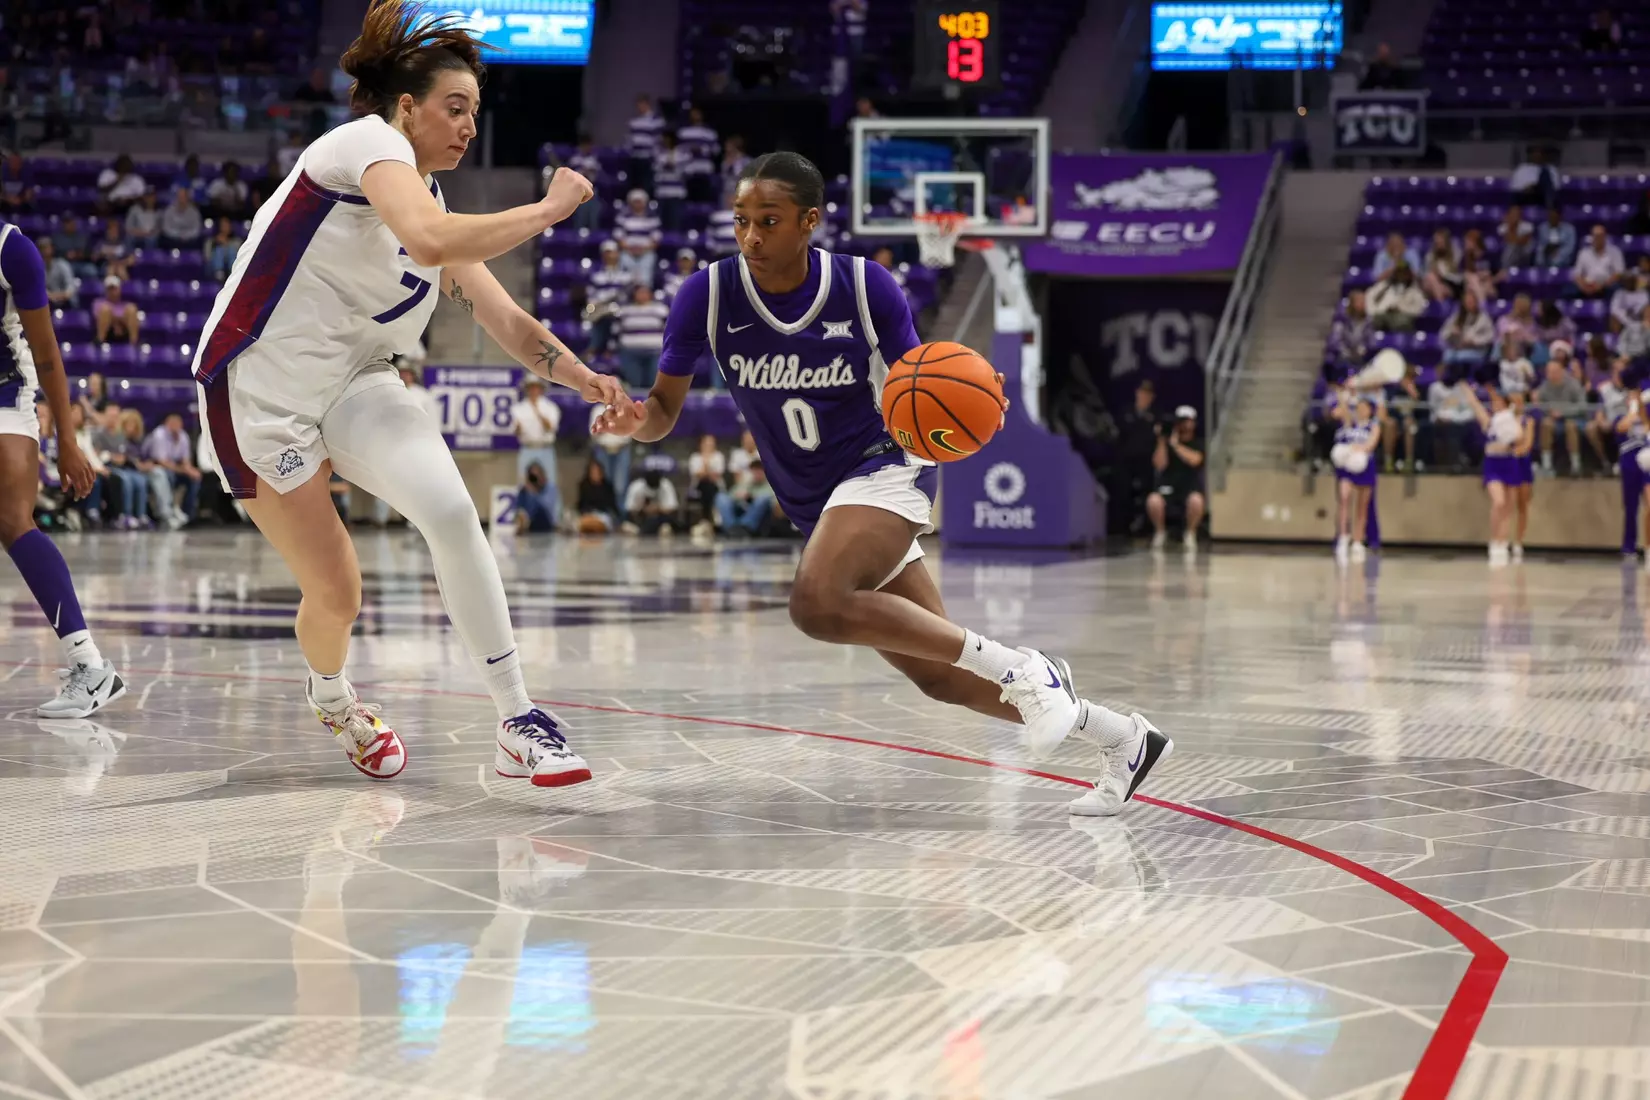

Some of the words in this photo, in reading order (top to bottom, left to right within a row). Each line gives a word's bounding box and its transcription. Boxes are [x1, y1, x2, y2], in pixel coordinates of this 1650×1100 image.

[947, 38, 984, 82] 13
[1339, 104, 1415, 144] TCU
[1098, 221, 1216, 243] EECU
[729, 353, 857, 390] Wildcats
[437, 394, 512, 428] 108
[781, 398, 821, 451] 0
[496, 493, 518, 525] 2
[974, 501, 1035, 529] Frost
